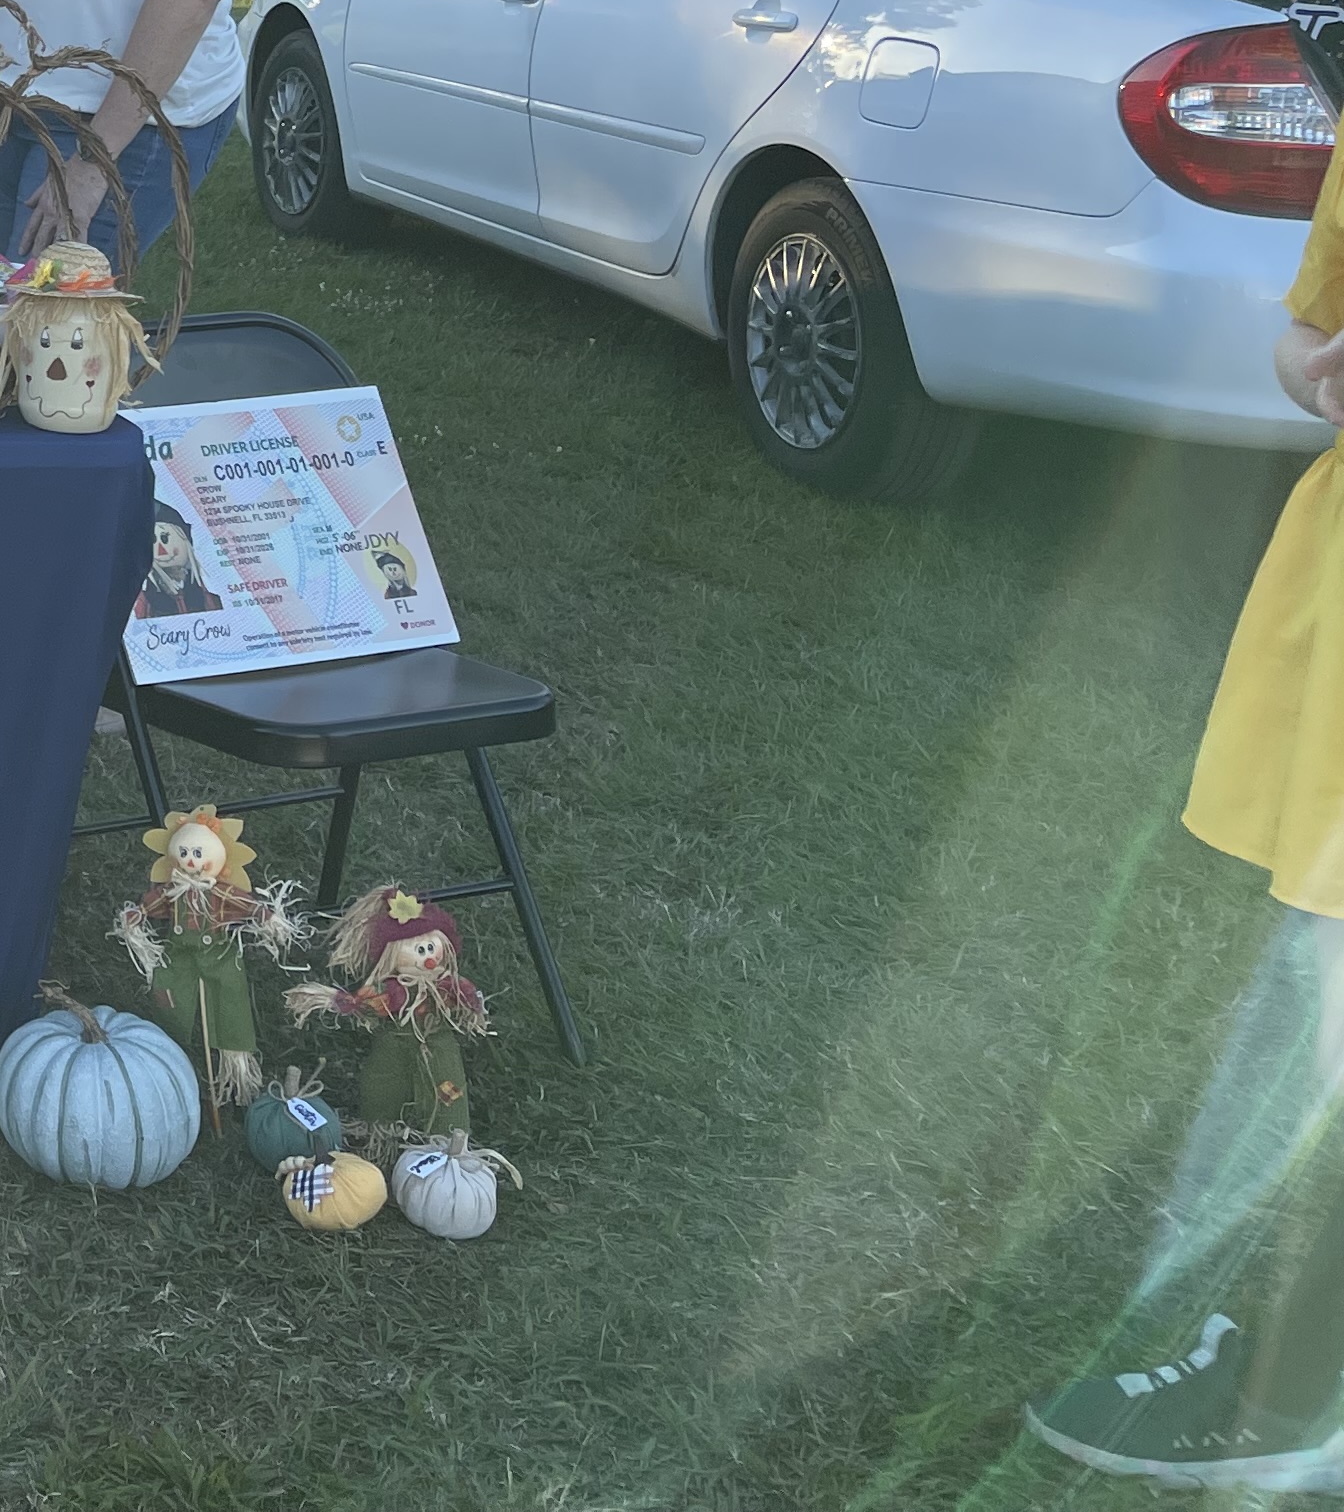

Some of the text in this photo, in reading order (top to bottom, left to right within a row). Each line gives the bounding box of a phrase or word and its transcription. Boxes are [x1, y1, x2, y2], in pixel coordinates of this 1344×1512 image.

[357, 412, 375, 421] USA
[200, 436, 300, 458] DRIVER LICENSE
[213, 450, 355, 481] C001-001-01-001-0
[376, 440, 388, 455] E
[196, 484, 223, 495] CROW
[199, 495, 228, 506] SCARY
[257, 500, 286, 511] HOUSE
[287, 496, 312, 507] DRIVE
[334, 541, 363, 554] NONE
[227, 577, 289, 594] SAFE DRIVER
[393, 598, 414, 615] FL
[409, 619, 436, 629] DONOR
[146, 618, 231, 656] Scary Crow
